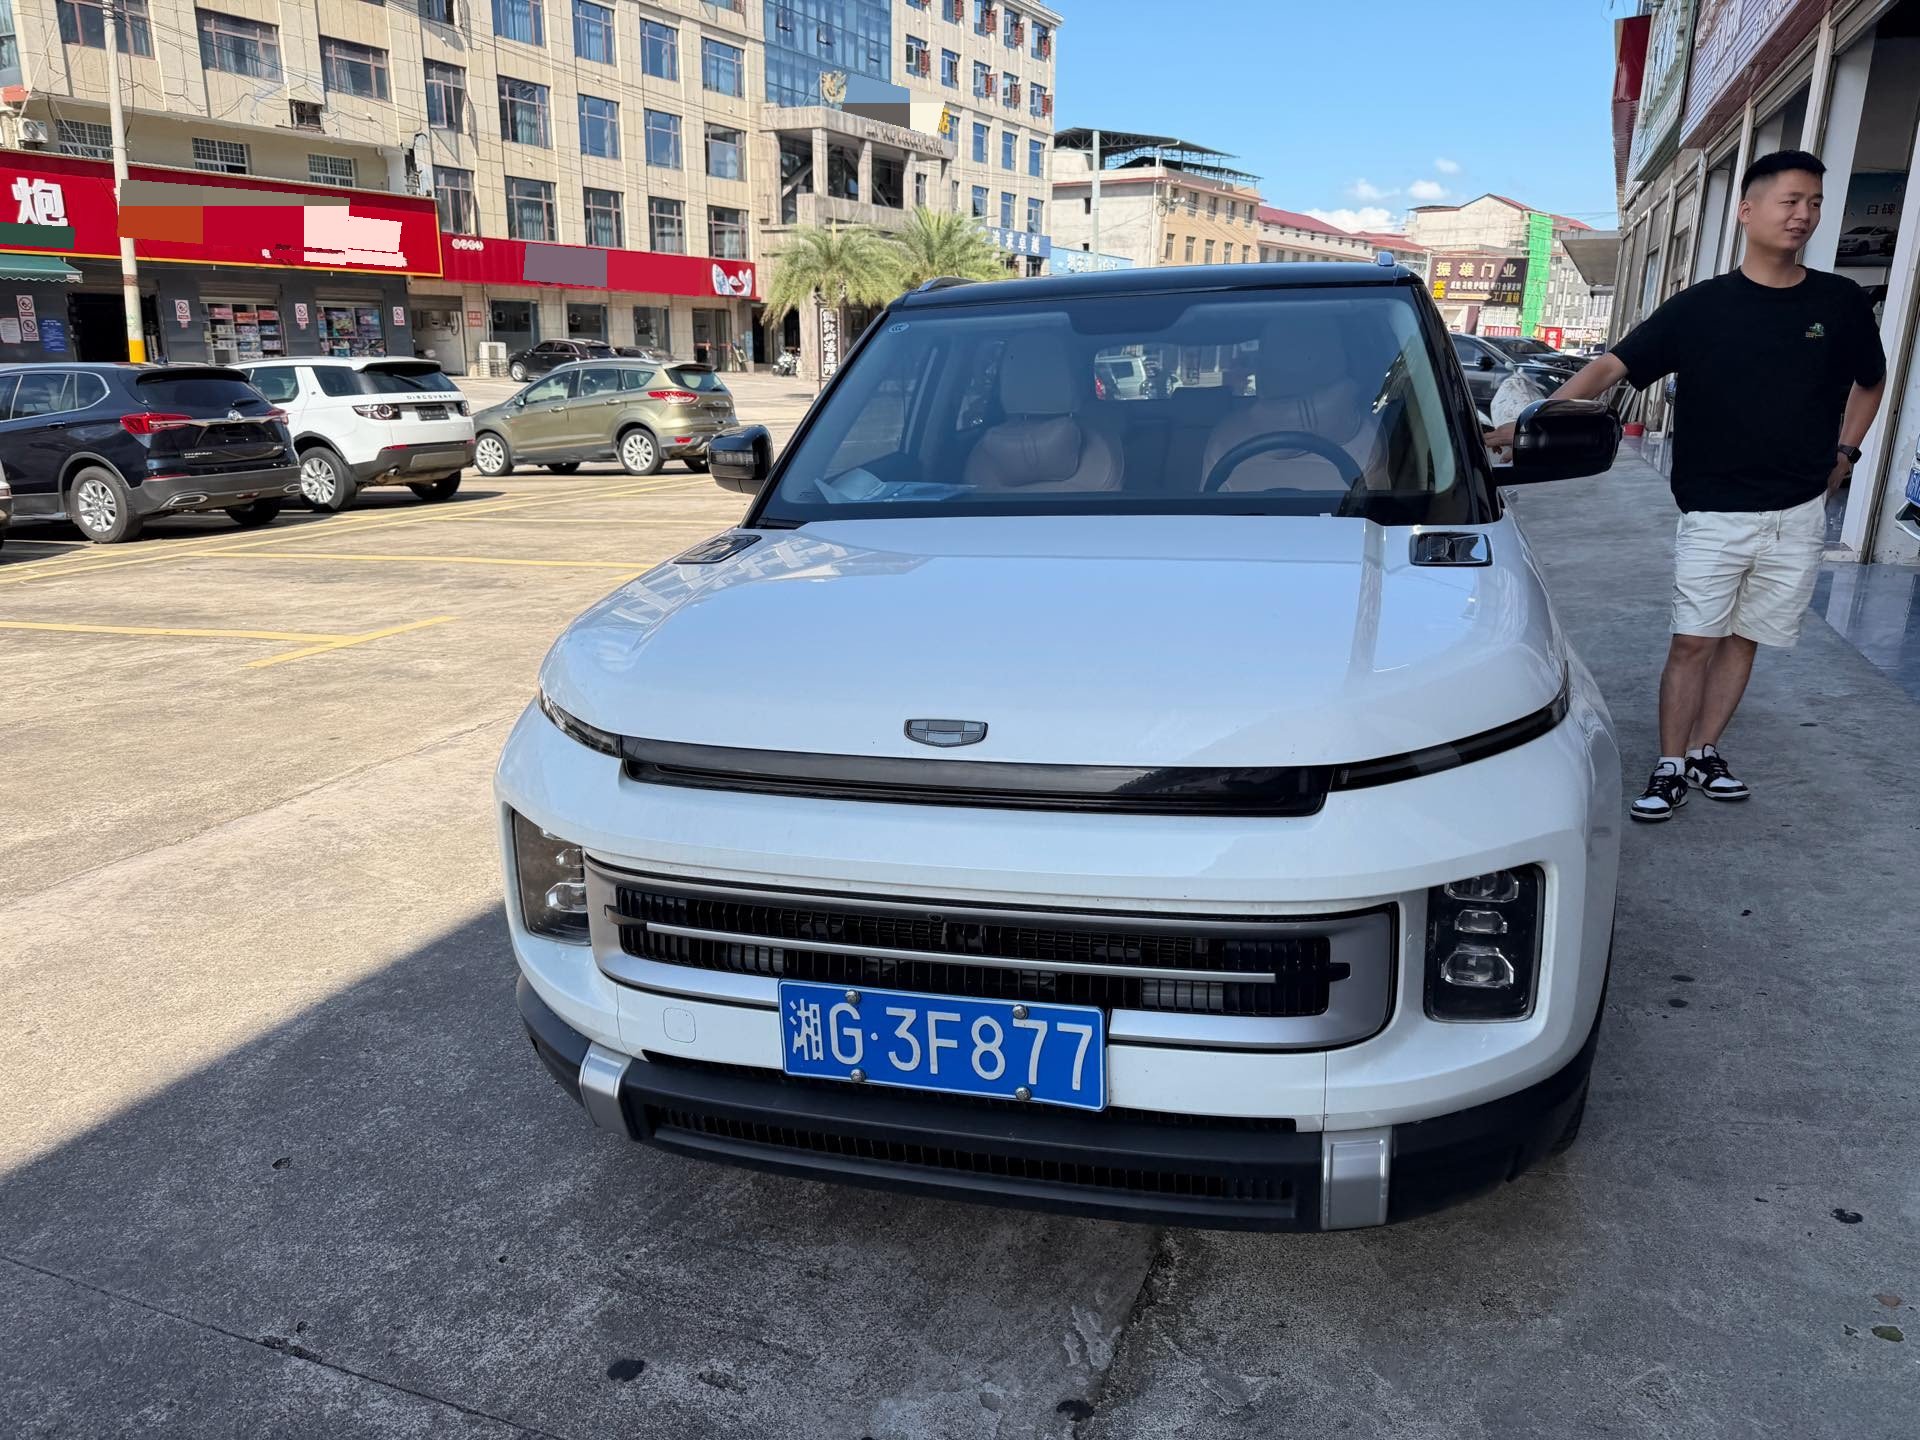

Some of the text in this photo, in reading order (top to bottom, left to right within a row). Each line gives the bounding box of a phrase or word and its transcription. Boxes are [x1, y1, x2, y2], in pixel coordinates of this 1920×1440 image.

[12, 177, 68, 227] 炮
[1436, 261, 1518, 279] 振雄门业
[789, 998, 1093, 1091] 湘G·3F877
